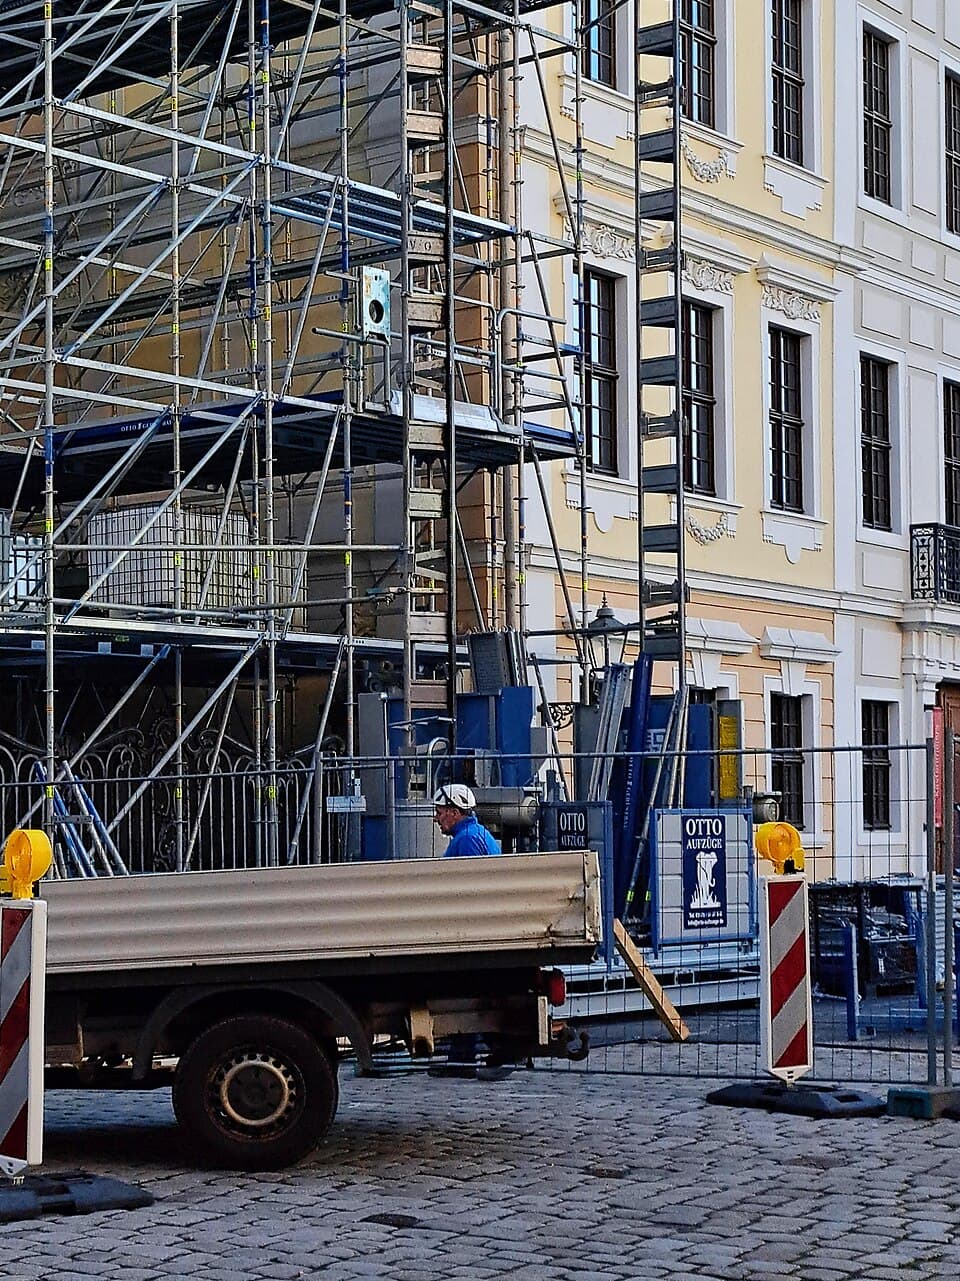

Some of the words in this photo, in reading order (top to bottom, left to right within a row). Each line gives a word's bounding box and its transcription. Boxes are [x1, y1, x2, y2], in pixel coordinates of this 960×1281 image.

[560, 812, 585, 832] OTTO
[686, 818, 722, 836] OTTO
[561, 832, 586, 847] AUFZÜGE
[686, 836, 723, 850] AUFZÜGE
